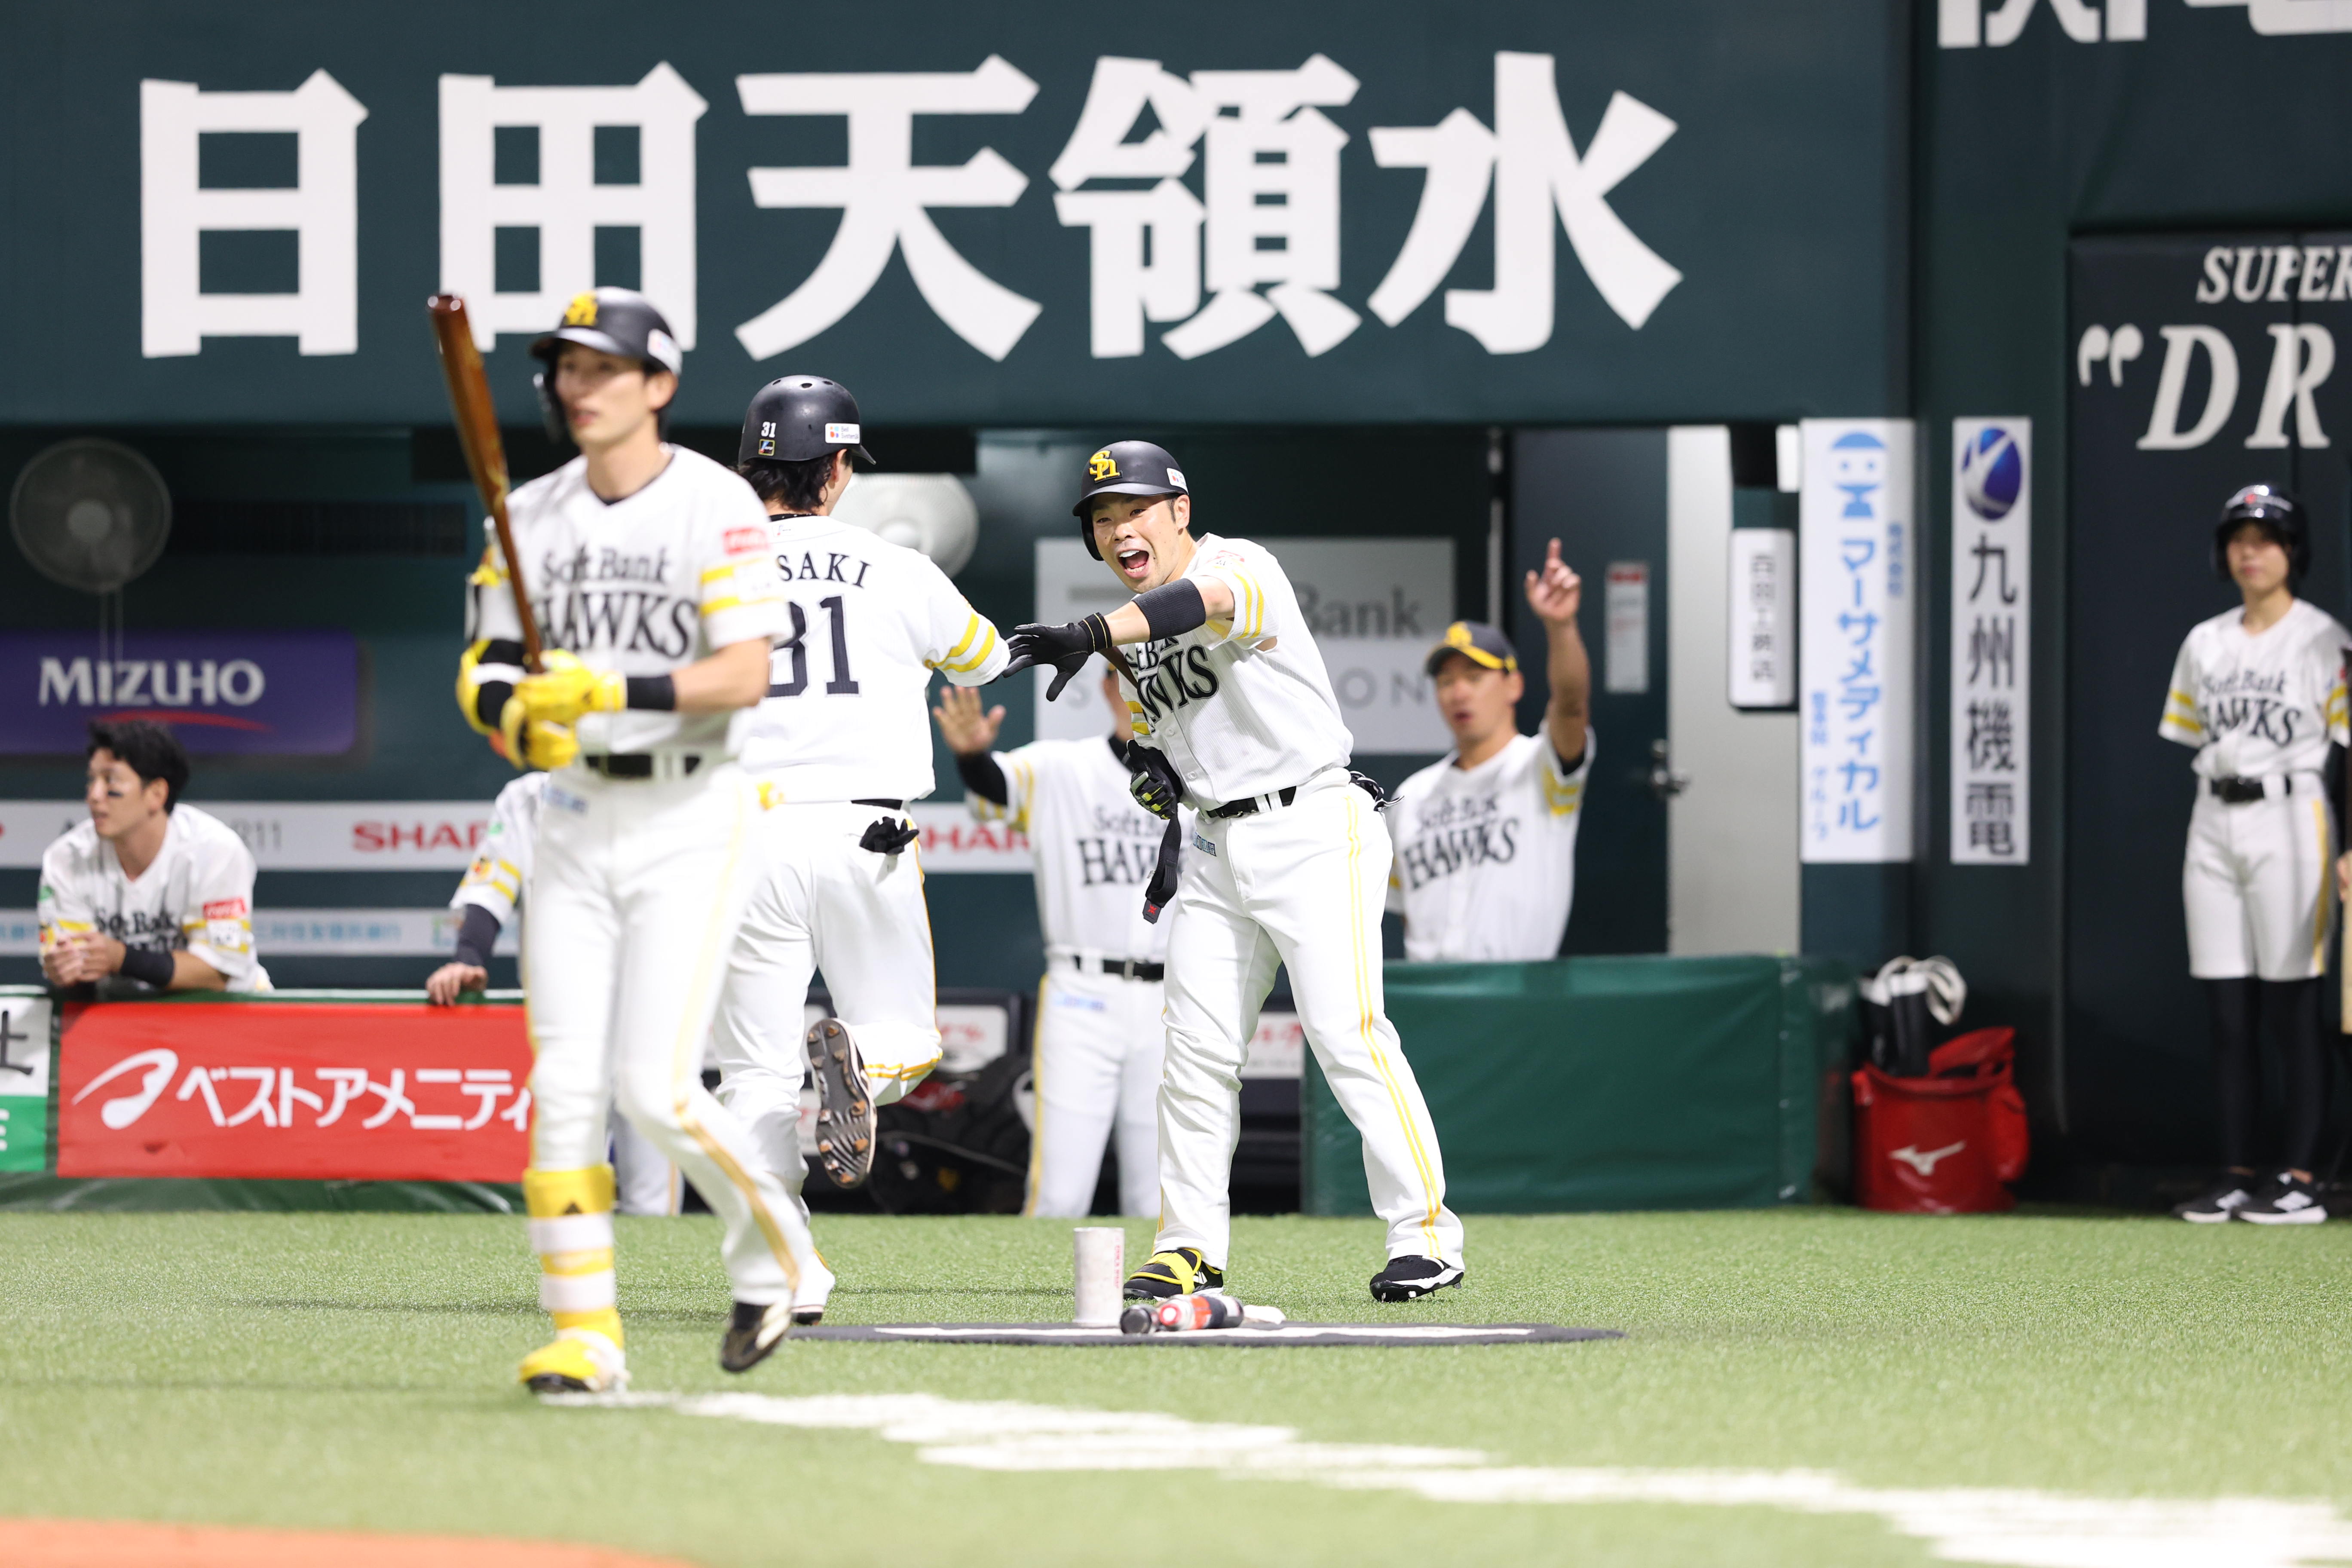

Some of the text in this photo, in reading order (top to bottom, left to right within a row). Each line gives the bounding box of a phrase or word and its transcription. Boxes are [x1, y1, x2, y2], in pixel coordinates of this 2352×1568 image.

[140, 52, 1683, 361] 日田天領水
[2196, 245, 2352, 303] SUPER
[760, 421, 777, 438] 31
[39, 656, 266, 706] MIZUHO
[1836, 537, 1880, 832] マーサメディカル
[1964, 536, 2018, 856] 九州機電
[176, 1065, 532, 1131] ベストアメニティ
